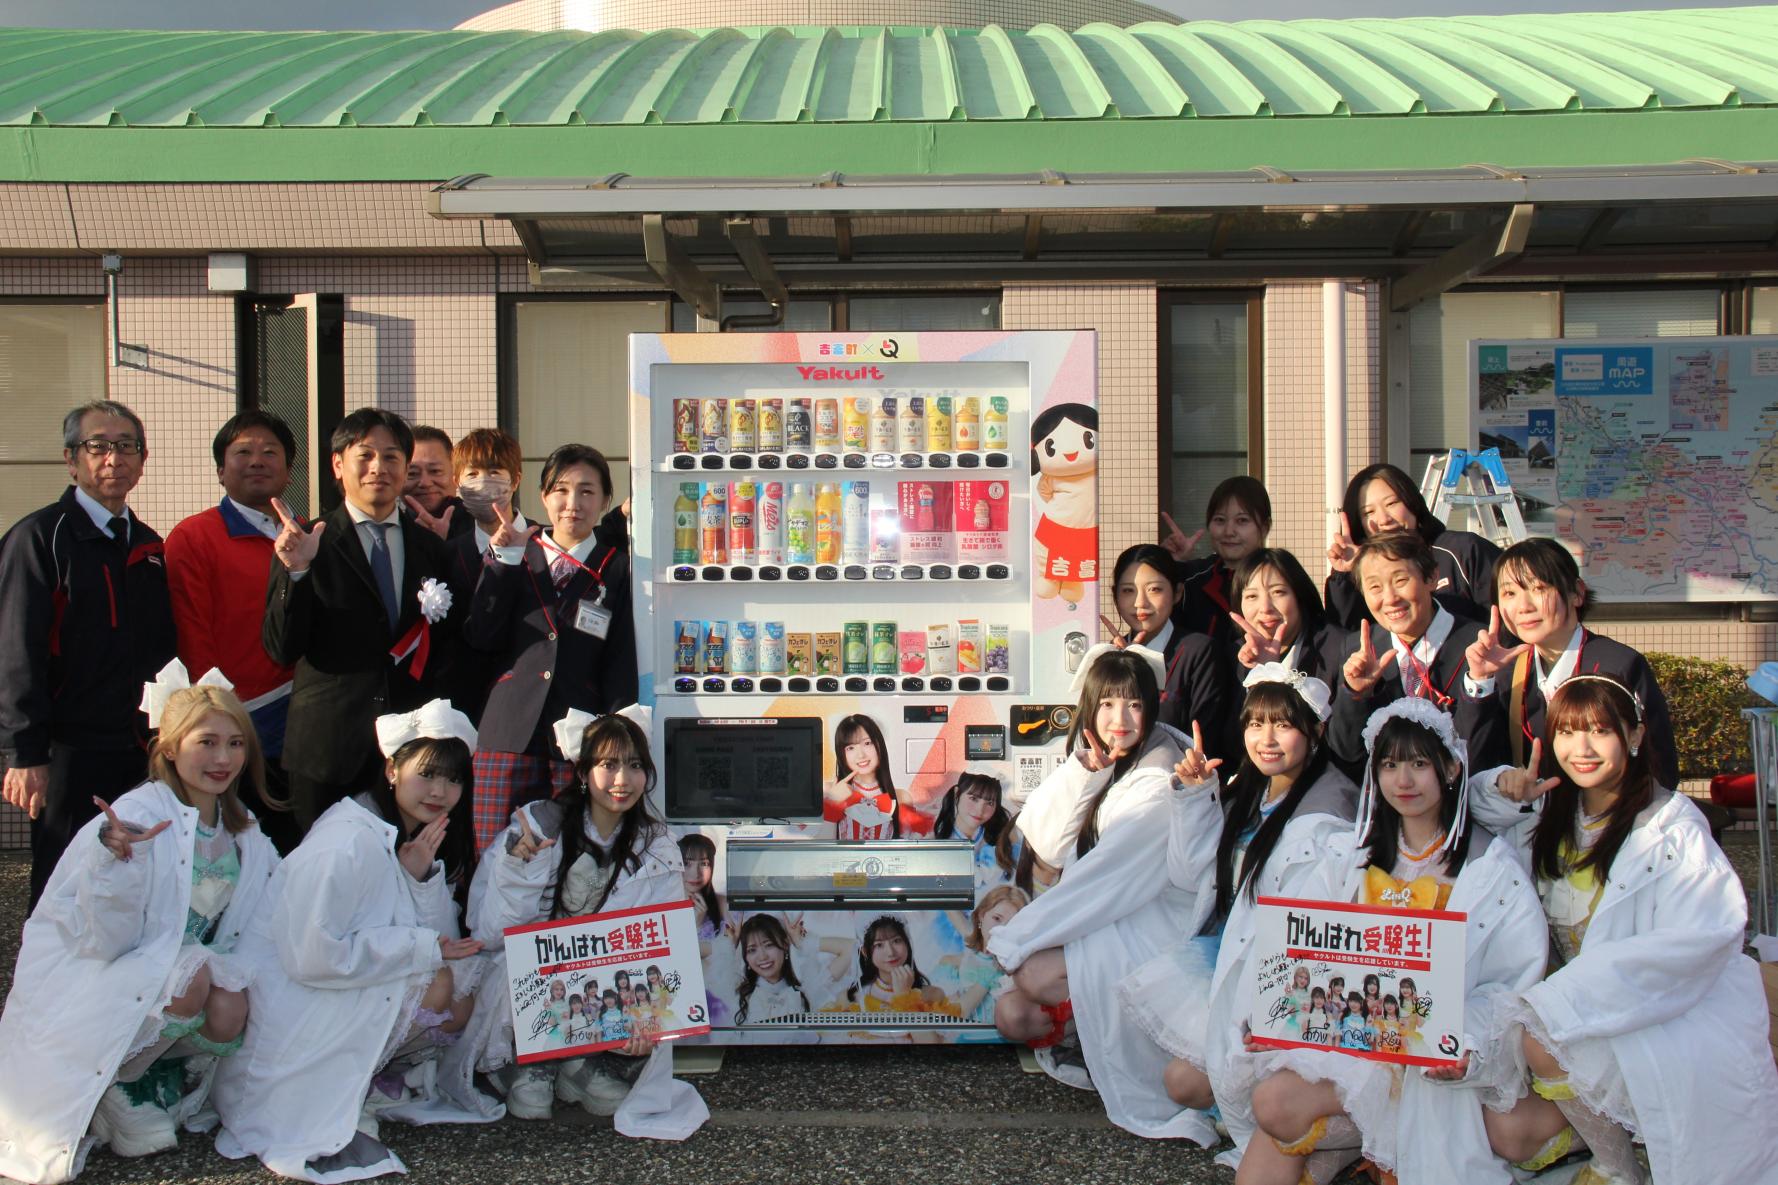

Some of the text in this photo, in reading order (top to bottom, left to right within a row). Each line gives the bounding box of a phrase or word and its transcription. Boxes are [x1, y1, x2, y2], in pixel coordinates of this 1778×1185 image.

[819, 343, 858, 356] 吉富町
[796, 366, 885, 381] Yakult
[1609, 368, 1645, 379] MAP
[1051, 556, 1097, 579] 吉富
